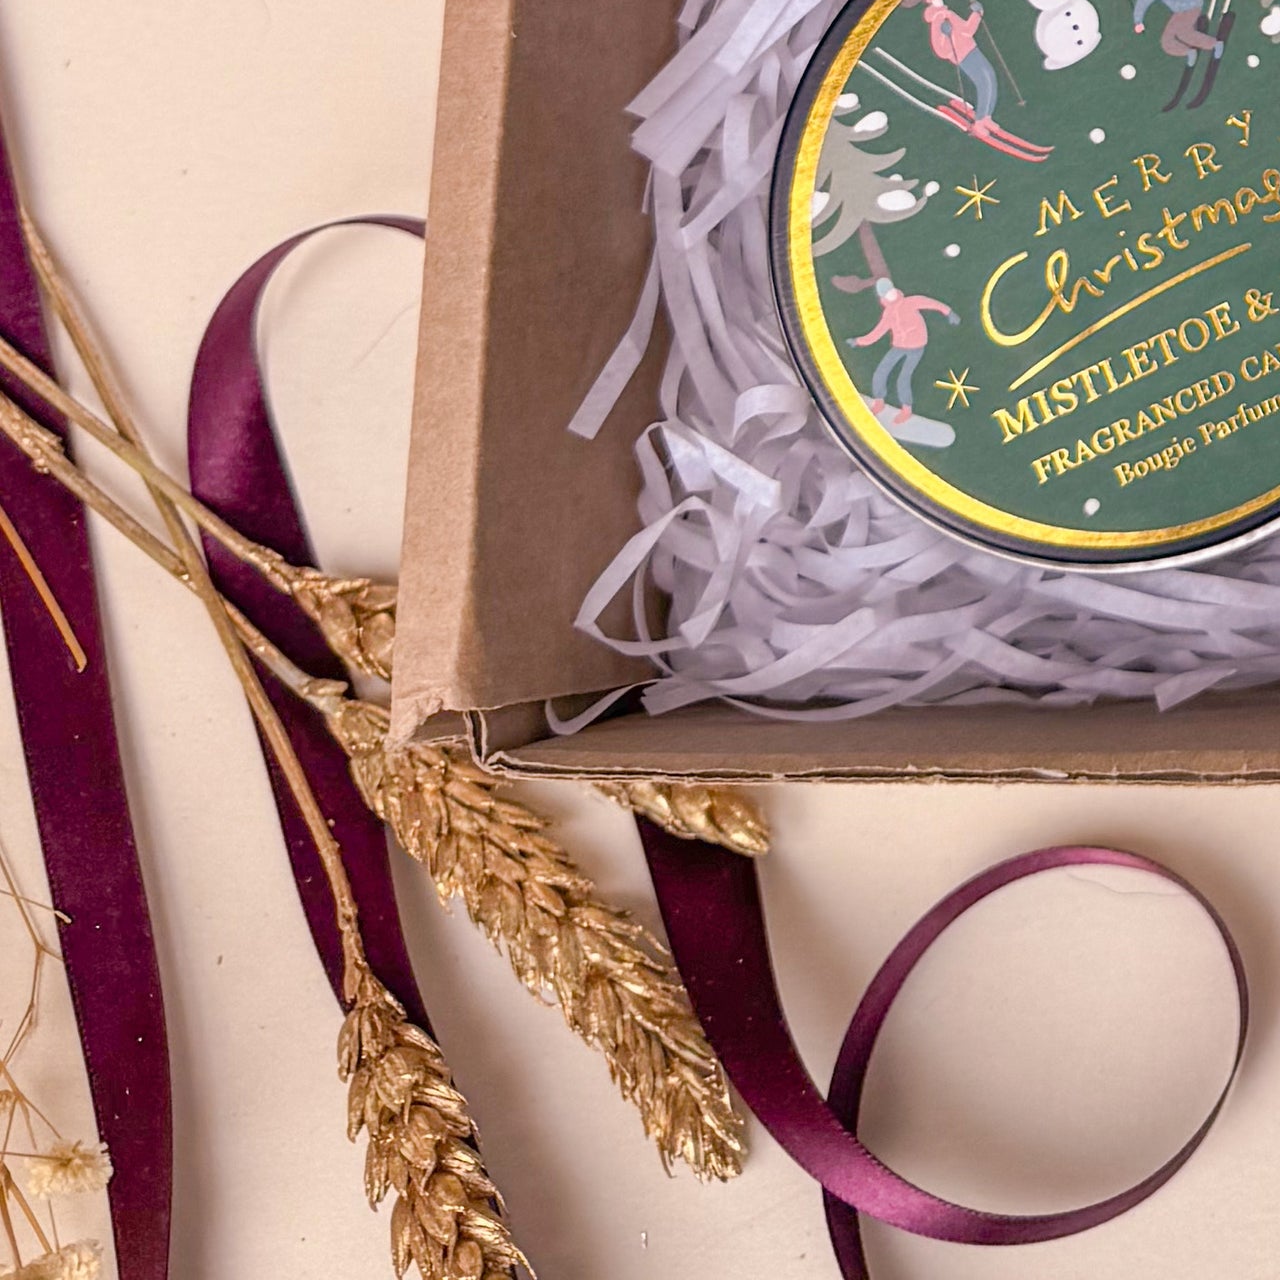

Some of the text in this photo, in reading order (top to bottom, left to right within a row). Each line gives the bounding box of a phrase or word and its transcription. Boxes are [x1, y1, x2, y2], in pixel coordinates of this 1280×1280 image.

[1033, 109, 1254, 236] MERRY
[991, 301, 1241, 444] MISTLETOE
[1243, 288, 1280, 322] &
[1030, 369, 1237, 486] FRAGRANCED
[1113, 436, 1197, 487] Bougie
